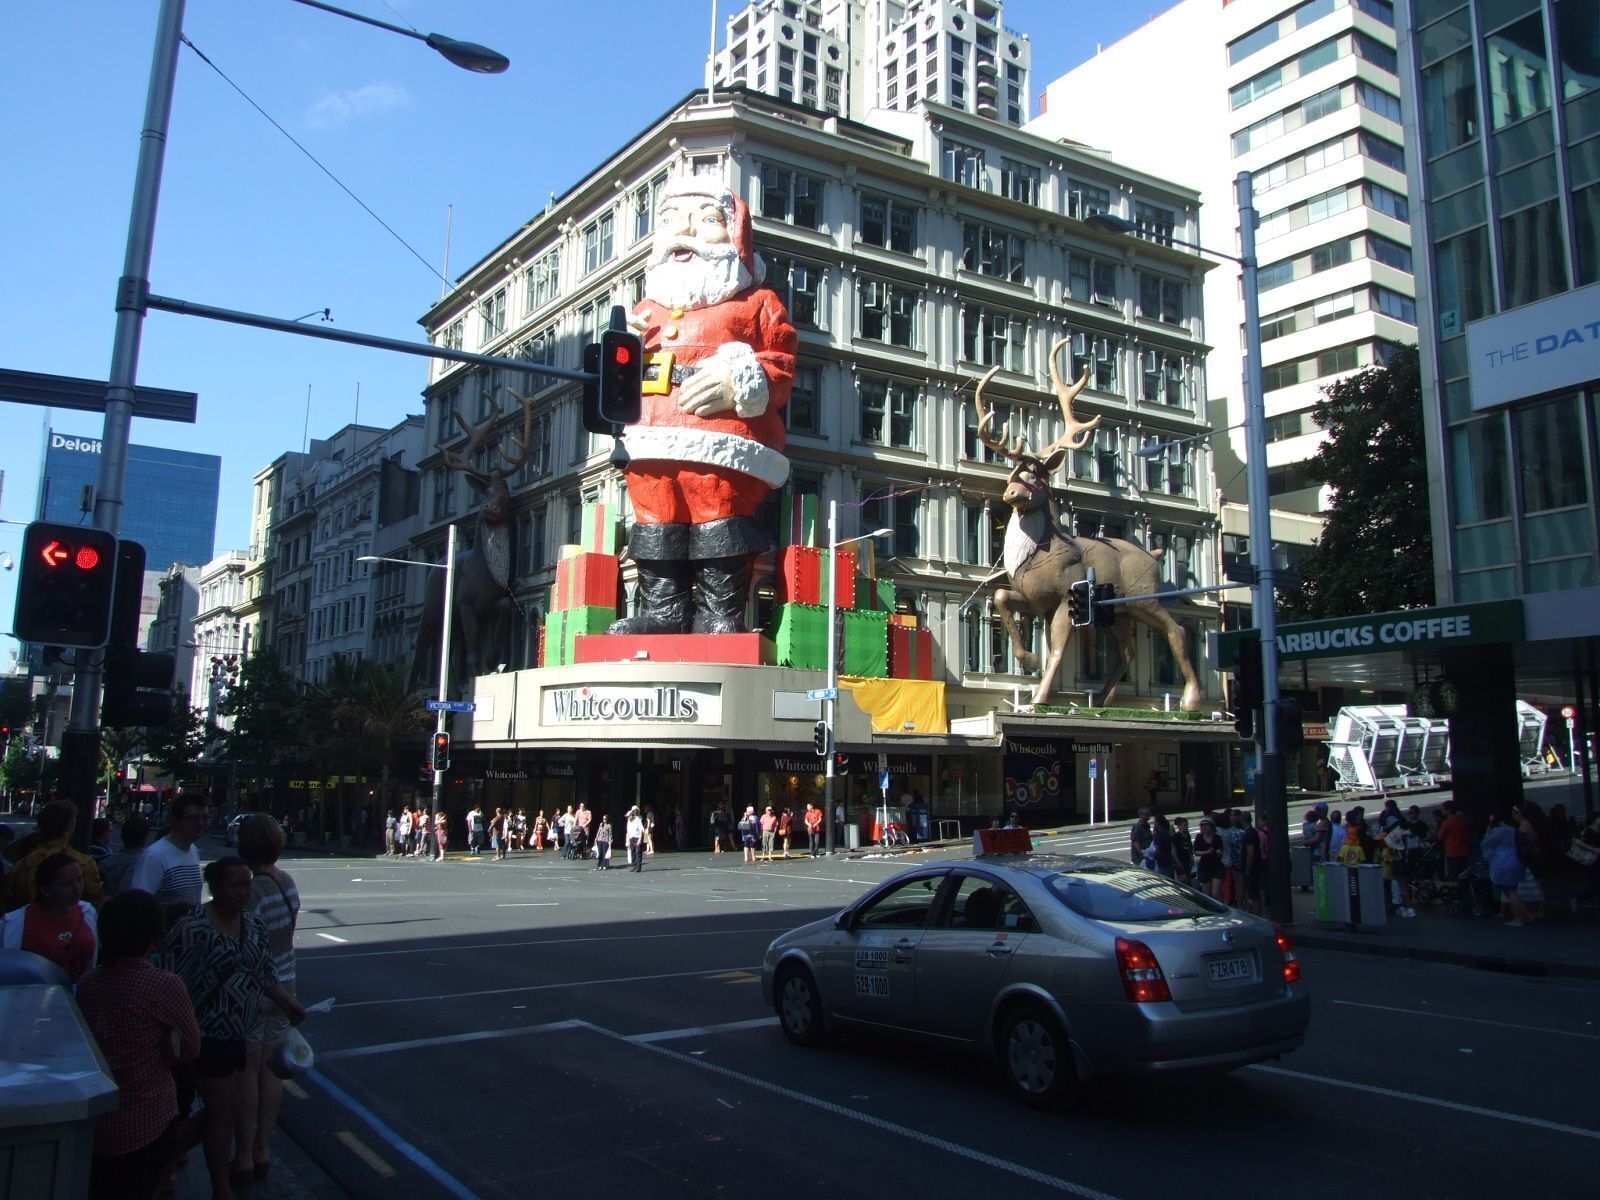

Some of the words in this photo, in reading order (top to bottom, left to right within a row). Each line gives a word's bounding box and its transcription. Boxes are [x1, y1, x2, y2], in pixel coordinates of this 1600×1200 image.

[1484, 342, 1529, 369] THE
[1535, 321, 1600, 356] DAT
[51, 434, 103, 454] Deloit
[1276, 625, 1375, 654] ARBUCKS
[1379, 615, 1471, 643] COFFEE
[429, 702, 451, 711] VICTORIA
[553, 687, 696, 721] Whitcoulls
[1009, 743, 1057, 755] Whitcoulls
[773, 759, 827, 772] Whitcoull
[485, 770, 528, 779] Whitcoulls
